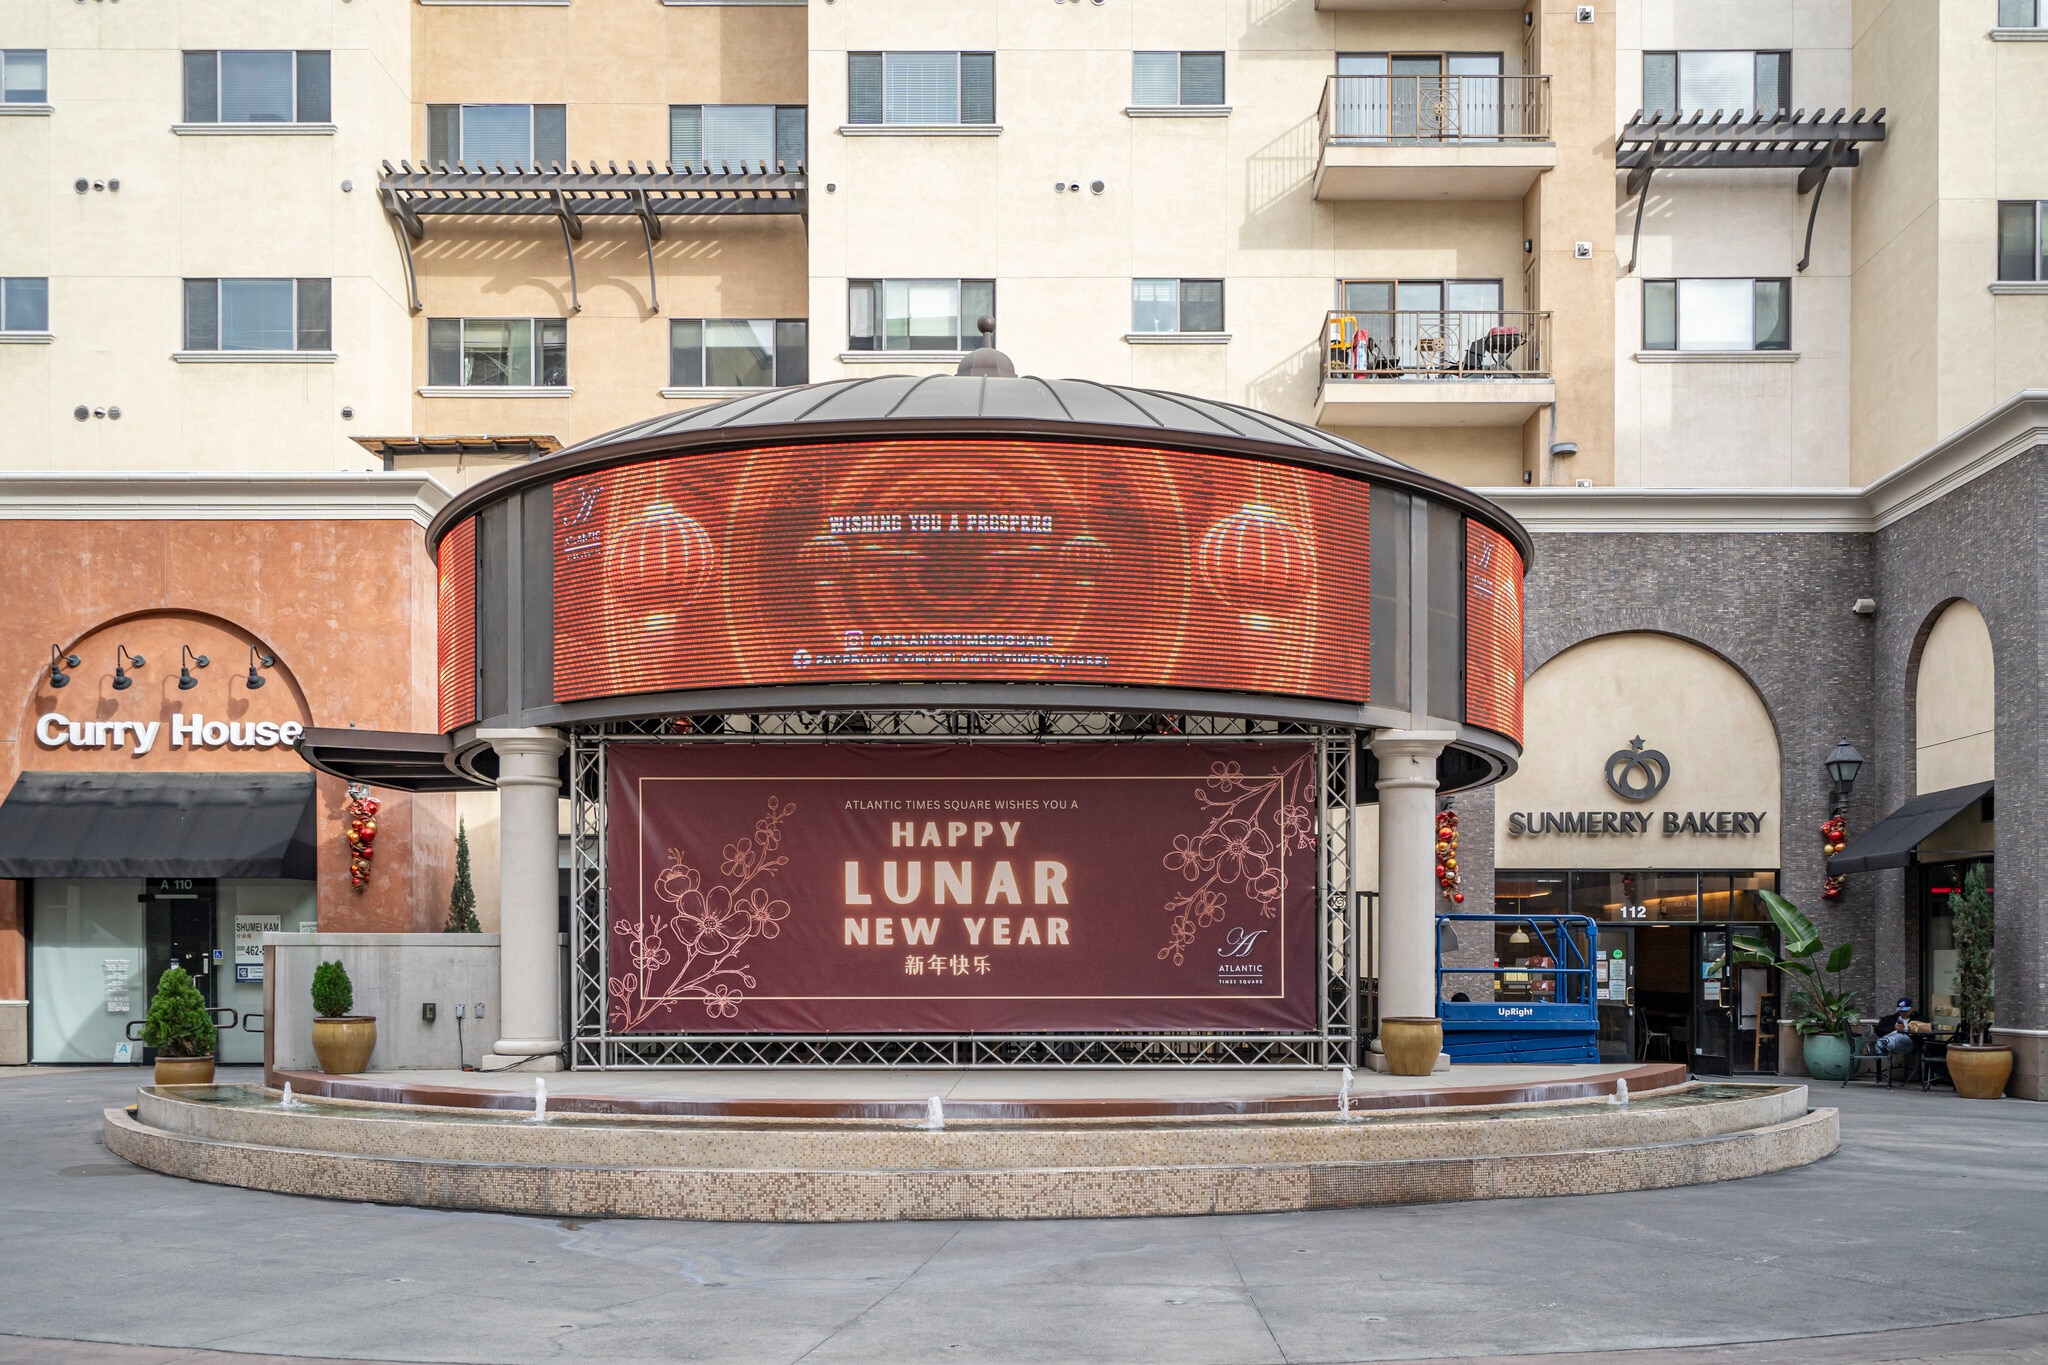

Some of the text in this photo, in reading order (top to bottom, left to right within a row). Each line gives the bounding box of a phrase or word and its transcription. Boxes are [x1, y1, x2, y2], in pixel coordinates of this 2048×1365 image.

[829, 515, 902, 534] WISHING
[908, 513, 942, 532] YOU
[949, 514, 961, 532] A
[36, 712, 303, 754] Curry House
[845, 800, 1079, 811] ATLANTIC TIMES SQUARE WISHES YOU A
[1508, 811, 1767, 835] SUNMERRY BAKERY
[892, 821, 1021, 847] HAPPY
[160, 880, 193, 890] A 110
[845, 861, 1069, 904] LUNAR
[1620, 906, 1647, 918] 112
[236, 922, 280, 932] SHUMEI KAM
[844, 917, 1070, 945] NEW YEAR
[904, 954, 991, 976] 新年快乐
[1218, 964, 1263, 973] ATLANTIC
[1498, 1007, 1533, 1017] UpRight
[118, 1043, 128, 1053] A
